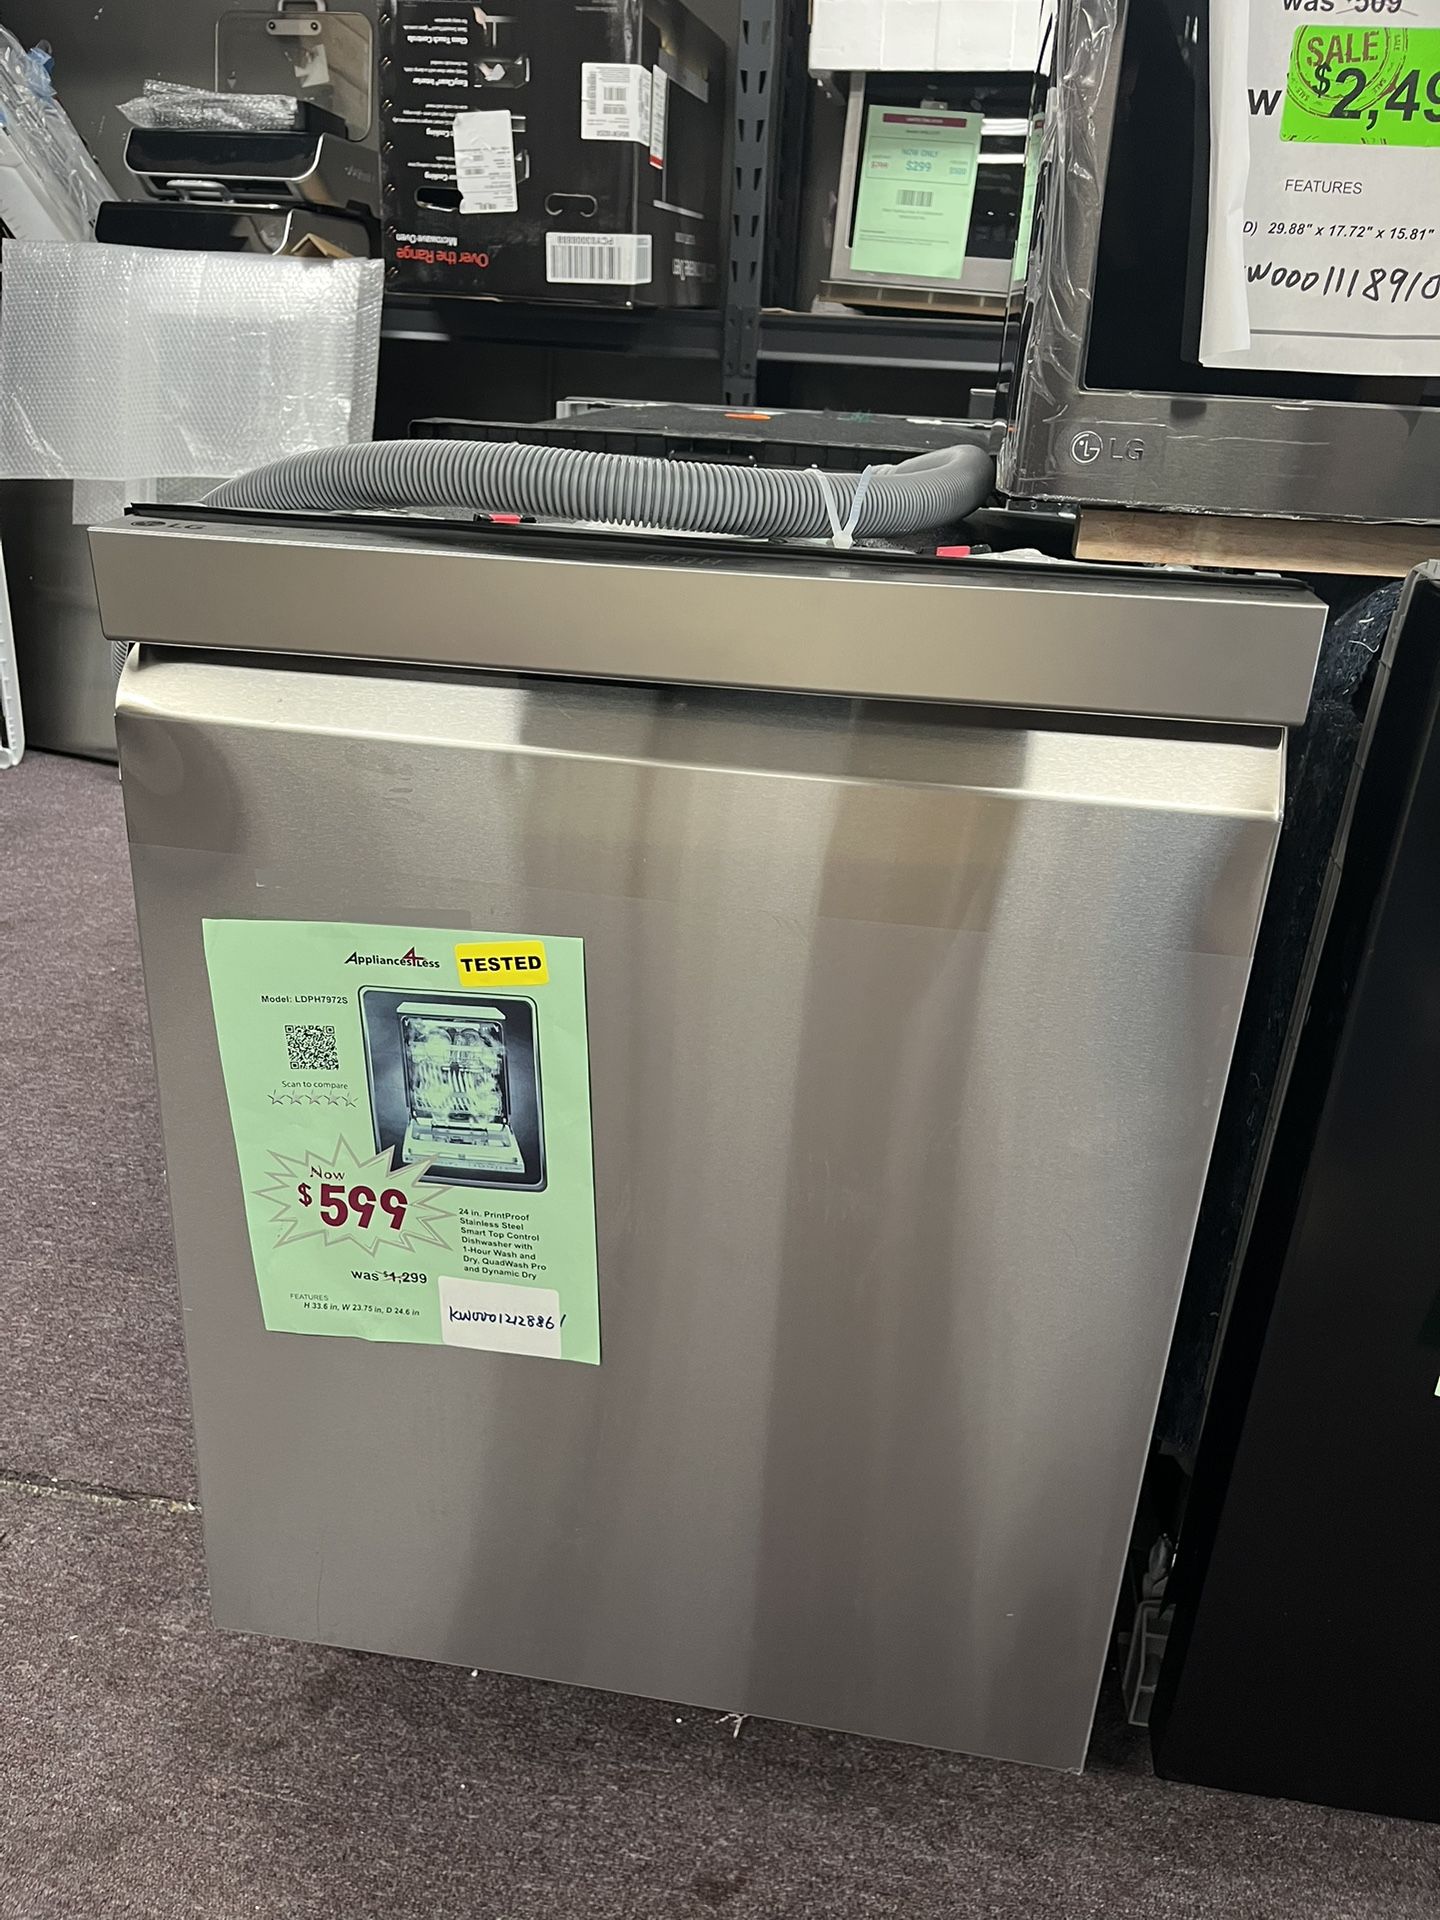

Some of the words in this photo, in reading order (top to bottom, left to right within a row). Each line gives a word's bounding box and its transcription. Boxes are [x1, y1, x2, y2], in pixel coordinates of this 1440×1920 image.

[1283, 0, 1334, 12] was
[1306, 31, 1380, 67] SALE
[905, 160, 931, 172] $299
[1285, 179, 1363, 195] FEATURES
[1268, 222, 1313, 236] 29.88"
[1315, 226, 1325, 236] x
[1329, 225, 1374, 238] 17.72"
[1376, 229, 1385, 239] x
[1390, 227, 1435, 240] 15.81"
[395, 233, 417, 244] Oven
[396, 245, 434, 264] Range
[436, 250, 457, 265] the
[459, 252, 489, 268] Over
[1110, 437, 1145, 461] LG
[460, 956, 542, 973] TESTED
[261, 995, 292, 1003] Model:
[295, 996, 348, 1004] LDPH7972S
[282, 1080, 301, 1088] Scan
[313, 1082, 348, 1090] compare
[310, 1165, 345, 1181] Now
[298, 1182, 408, 1230] $599
[459, 1207, 469, 1215] 24
[484, 1210, 529, 1221] PrintProof
[460, 1217, 499, 1229] Stainless
[502, 1221, 524, 1230] Steel
[461, 1226, 486, 1237] Smart
[488, 1230, 505, 1239] Top
[507, 1232, 540, 1241] Control
[461, 1236, 512, 1248] Dishwasher
[463, 1245, 491, 1255] 1-Hour
[493, 1249, 517, 1258] Wash
[482, 1257, 529, 1269] QuadWash
[531, 1262, 547, 1271] Pro
[351, 1270, 379, 1281] was
[383, 1270, 427, 1284] $1,299
[482, 1267, 520, 1277] Dynamic
[521, 1271, 537, 1280] Dry
[290, 1293, 329, 1301] FEATURES
[312, 1302, 328, 1310] 33.6
[352, 1304, 373, 1312] 23.75
[394, 1307, 410, 1315] 24.6
